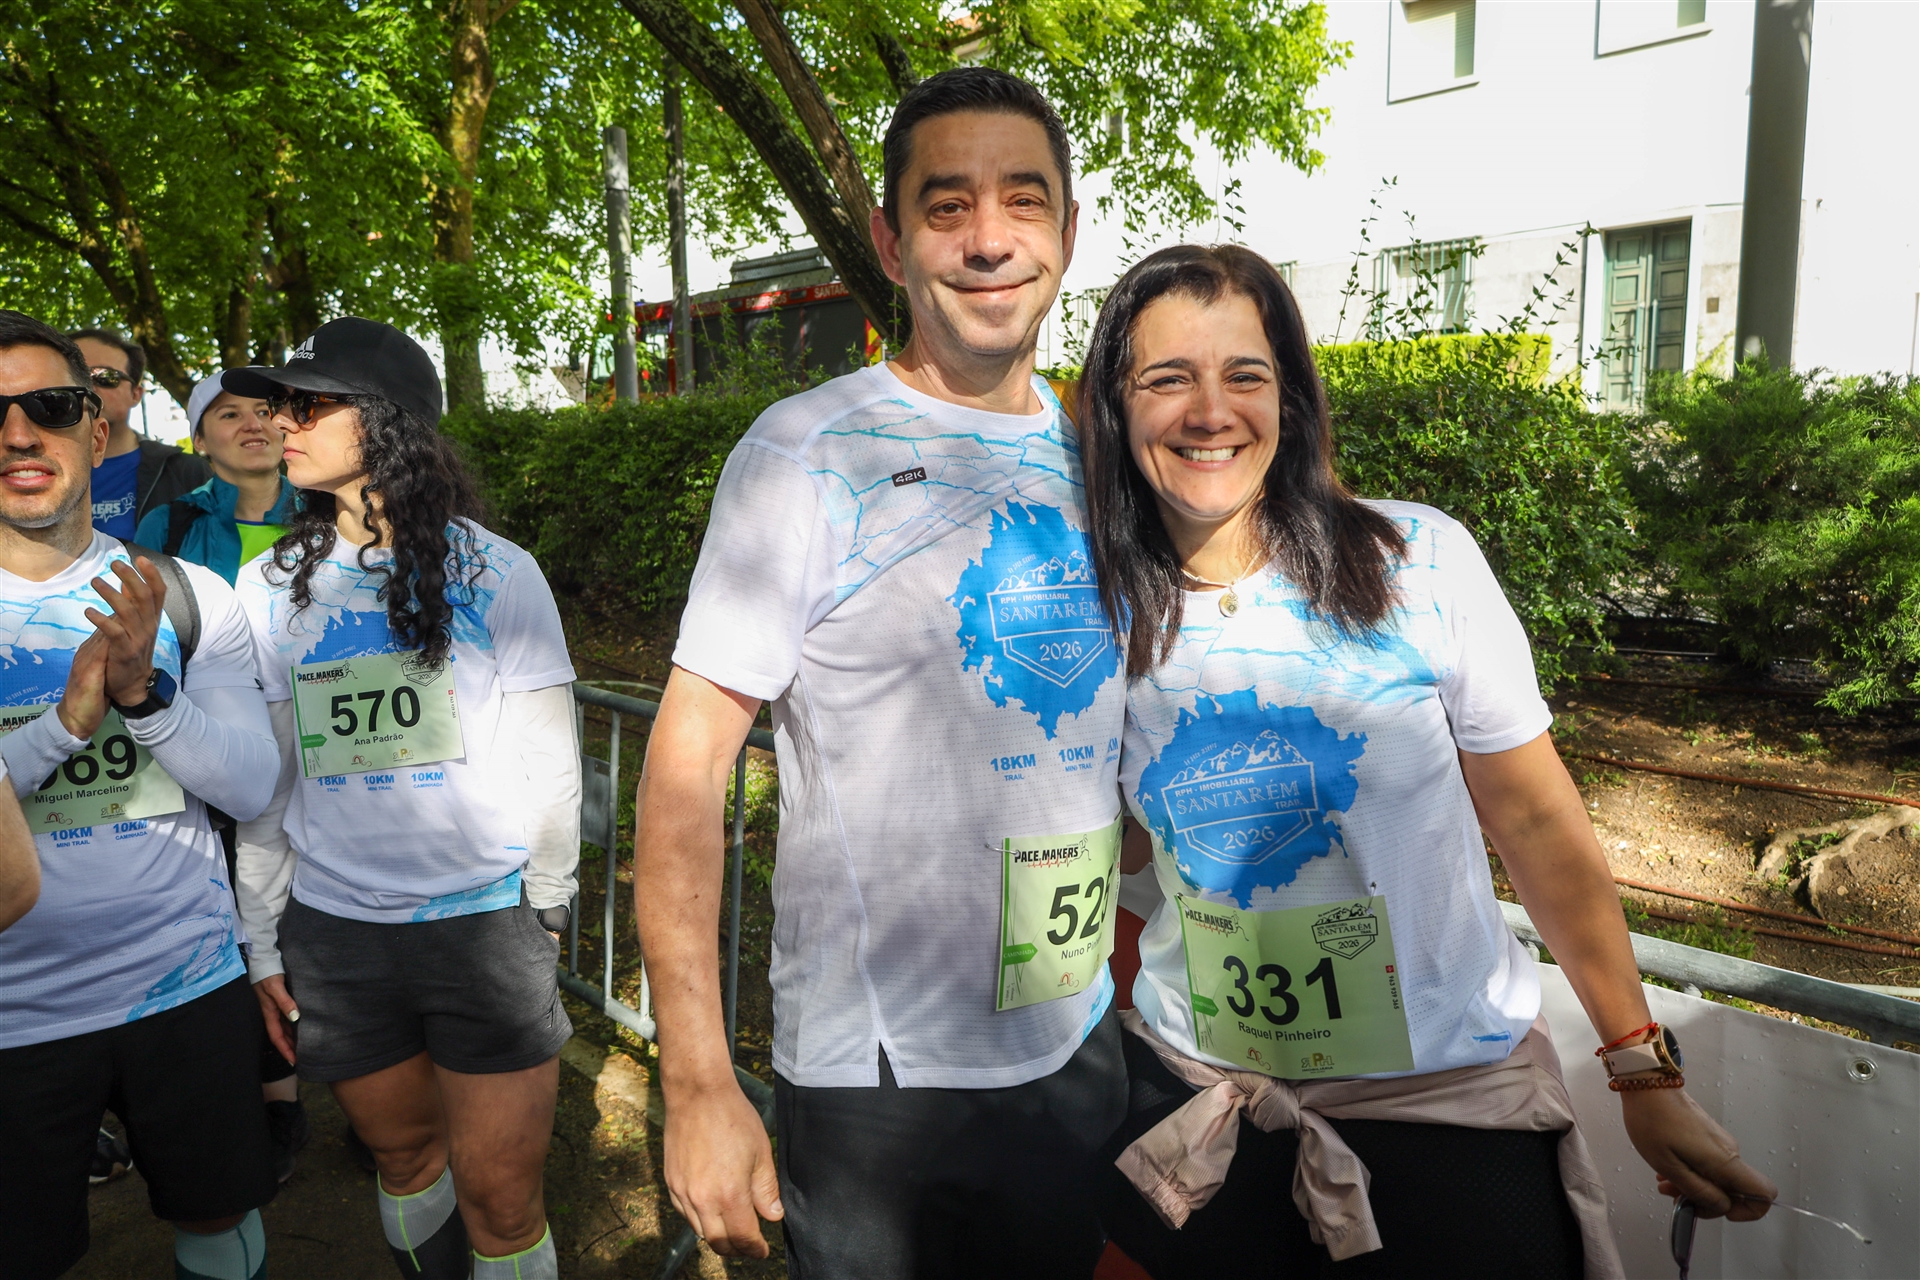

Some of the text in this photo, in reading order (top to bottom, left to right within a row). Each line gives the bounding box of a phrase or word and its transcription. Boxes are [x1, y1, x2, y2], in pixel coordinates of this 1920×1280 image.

[895, 470, 924, 483] 42K
[1000, 597, 1017, 605] RPH
[1000, 597, 1103, 623] SANTARÉM
[1084, 618, 1104, 626] TRAIL
[1039, 640, 1083, 662] 2026
[331, 686, 421, 736] 570
[354, 733, 404, 746] Ana Padrão
[1058, 745, 1095, 762] 10KM
[38, 734, 137, 791] 69
[990, 754, 1037, 772] 18KM
[1065, 762, 1093, 773] MINI TRAIL
[317, 776, 347, 787] 18KM
[363, 774, 395, 785] 10KM
[411, 771, 444, 782] 10KM
[1004, 773, 1024, 782] TRAIL
[34, 785, 130, 804] Miguel Marcelino
[1175, 788, 1193, 798] RPH
[1199, 776, 1255, 792] IMOBILIÁRIA
[1176, 779, 1300, 814] SANTARÉM
[50, 827, 93, 841] 10KM
[112, 819, 148, 834] 10KM
[115, 831, 148, 841] CAMINHADA
[1222, 826, 1275, 850] 2026
[1014, 846, 1079, 863] PACE.MAKERS
[1317, 922, 1372, 937] SANTARÉM
[1061, 947, 1085, 960] Nuno
[1223, 955, 1342, 1026] 331
[1238, 1021, 1332, 1042] Raquel Pinheiro
